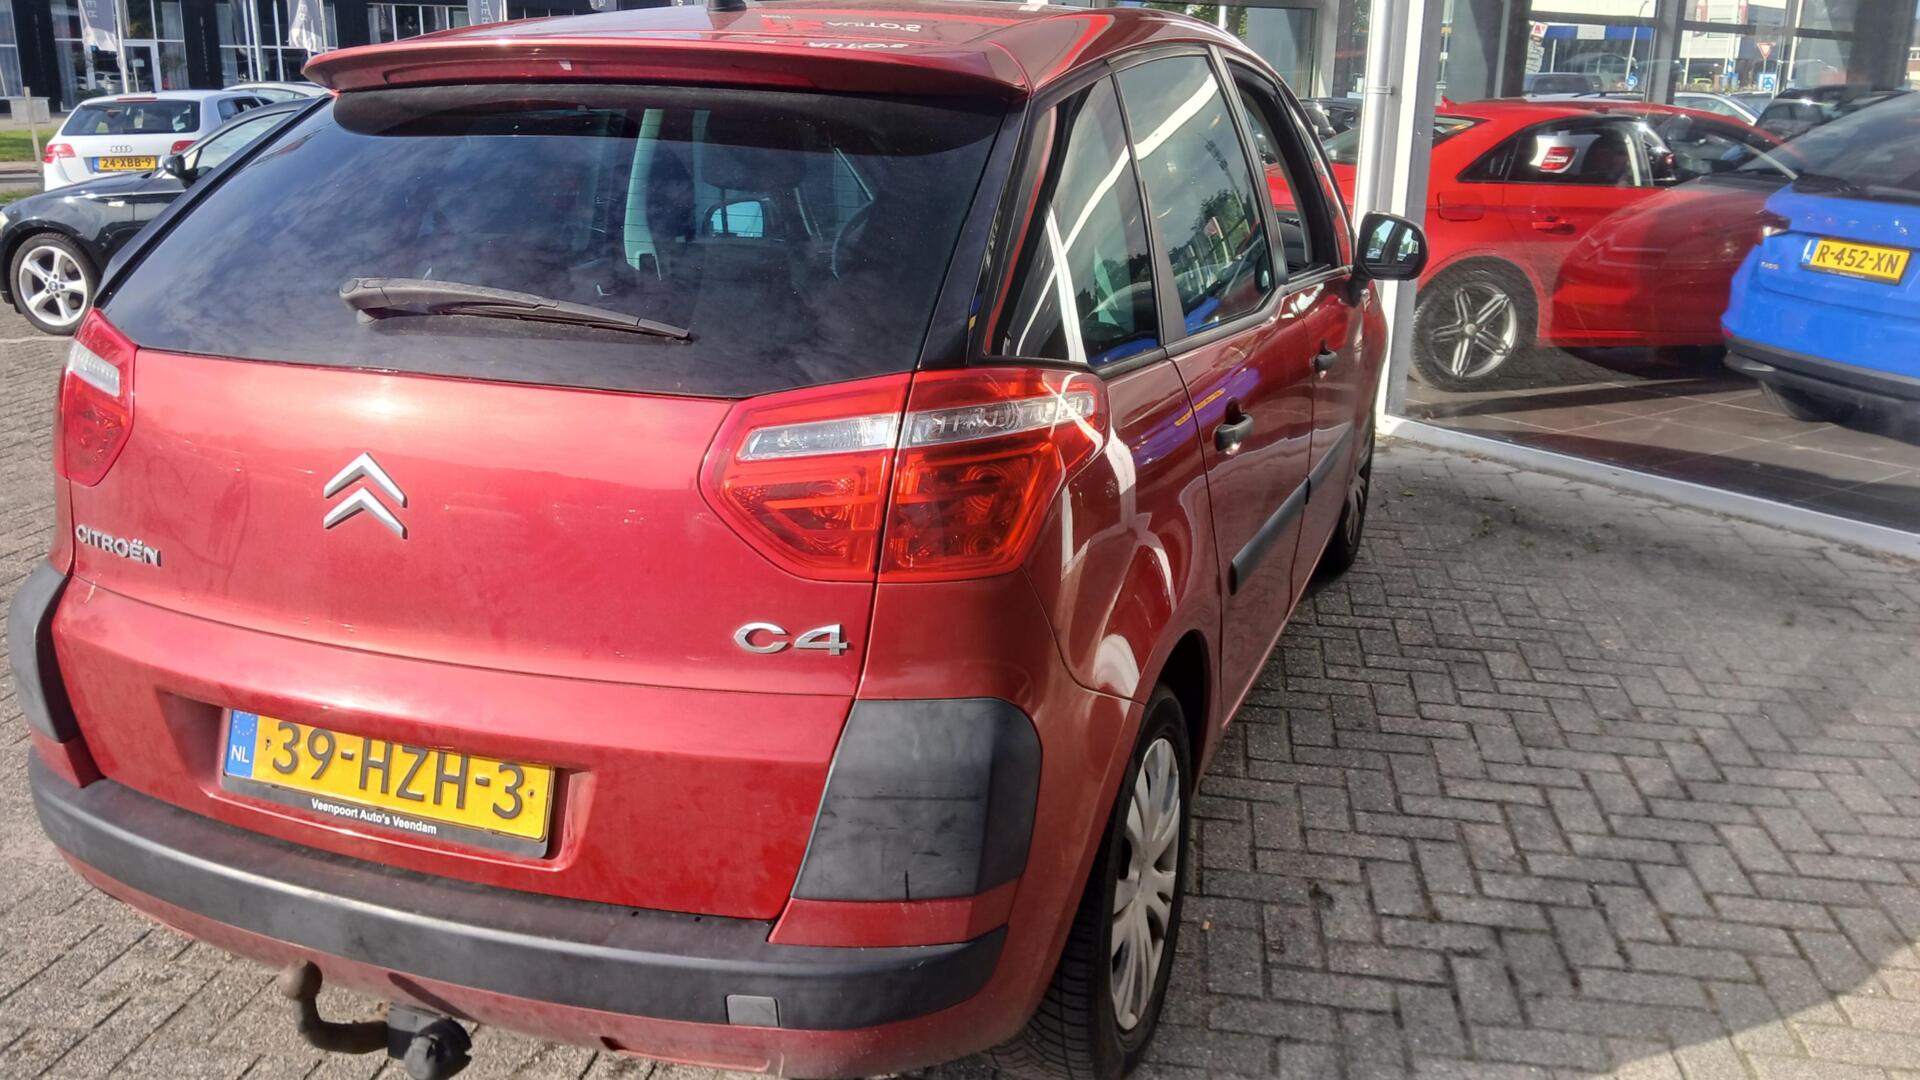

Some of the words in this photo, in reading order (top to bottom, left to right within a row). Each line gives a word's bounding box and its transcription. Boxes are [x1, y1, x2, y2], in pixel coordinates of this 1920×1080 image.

[102, 156, 152, 168] 24-XBB-9
[1816, 244, 1901, 274] R-452-XN
[75, 524, 161, 567] CITROËN
[733, 622, 848, 656] C4
[230, 744, 250, 763] NL
[272, 721, 525, 820] 39-HZH-3
[311, 798, 358, 818] Veenpoort
[360, 809, 391, 825] Auto's
[392, 815, 437, 835] Veendam
